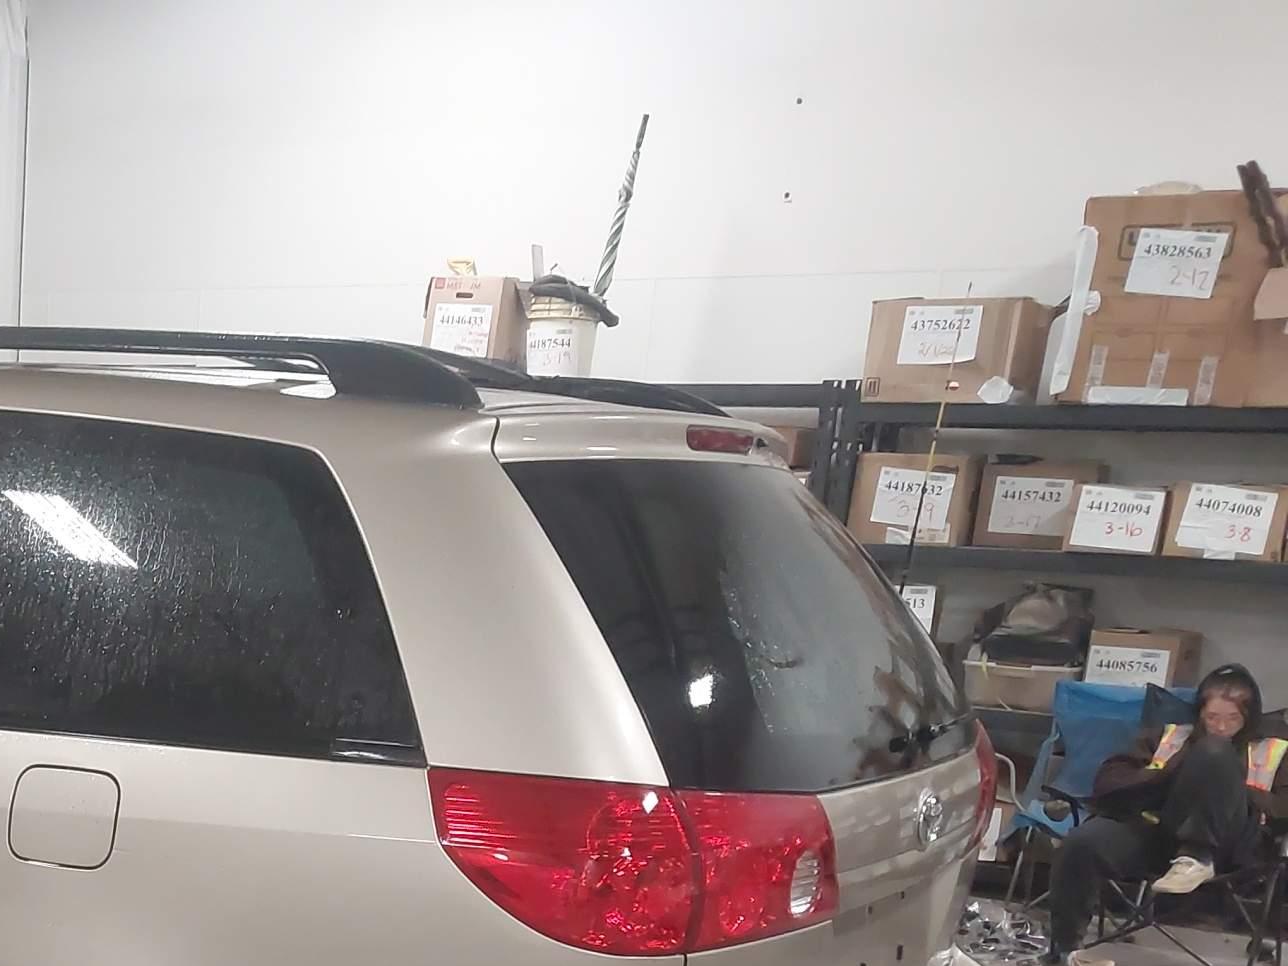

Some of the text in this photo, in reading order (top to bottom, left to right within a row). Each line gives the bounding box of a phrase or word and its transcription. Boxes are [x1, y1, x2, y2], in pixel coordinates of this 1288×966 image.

[1144, 244, 1212, 260] 43828563
[910, 318, 971, 331] 43752622
[1001, 490, 1062, 503] 44157432
[1086, 500, 1152, 517] 44120094
[1195, 497, 1263, 518] 44074008
[1104, 521, 1143, 537] 3-16
[1096, 659, 1158, 674] 44085756
